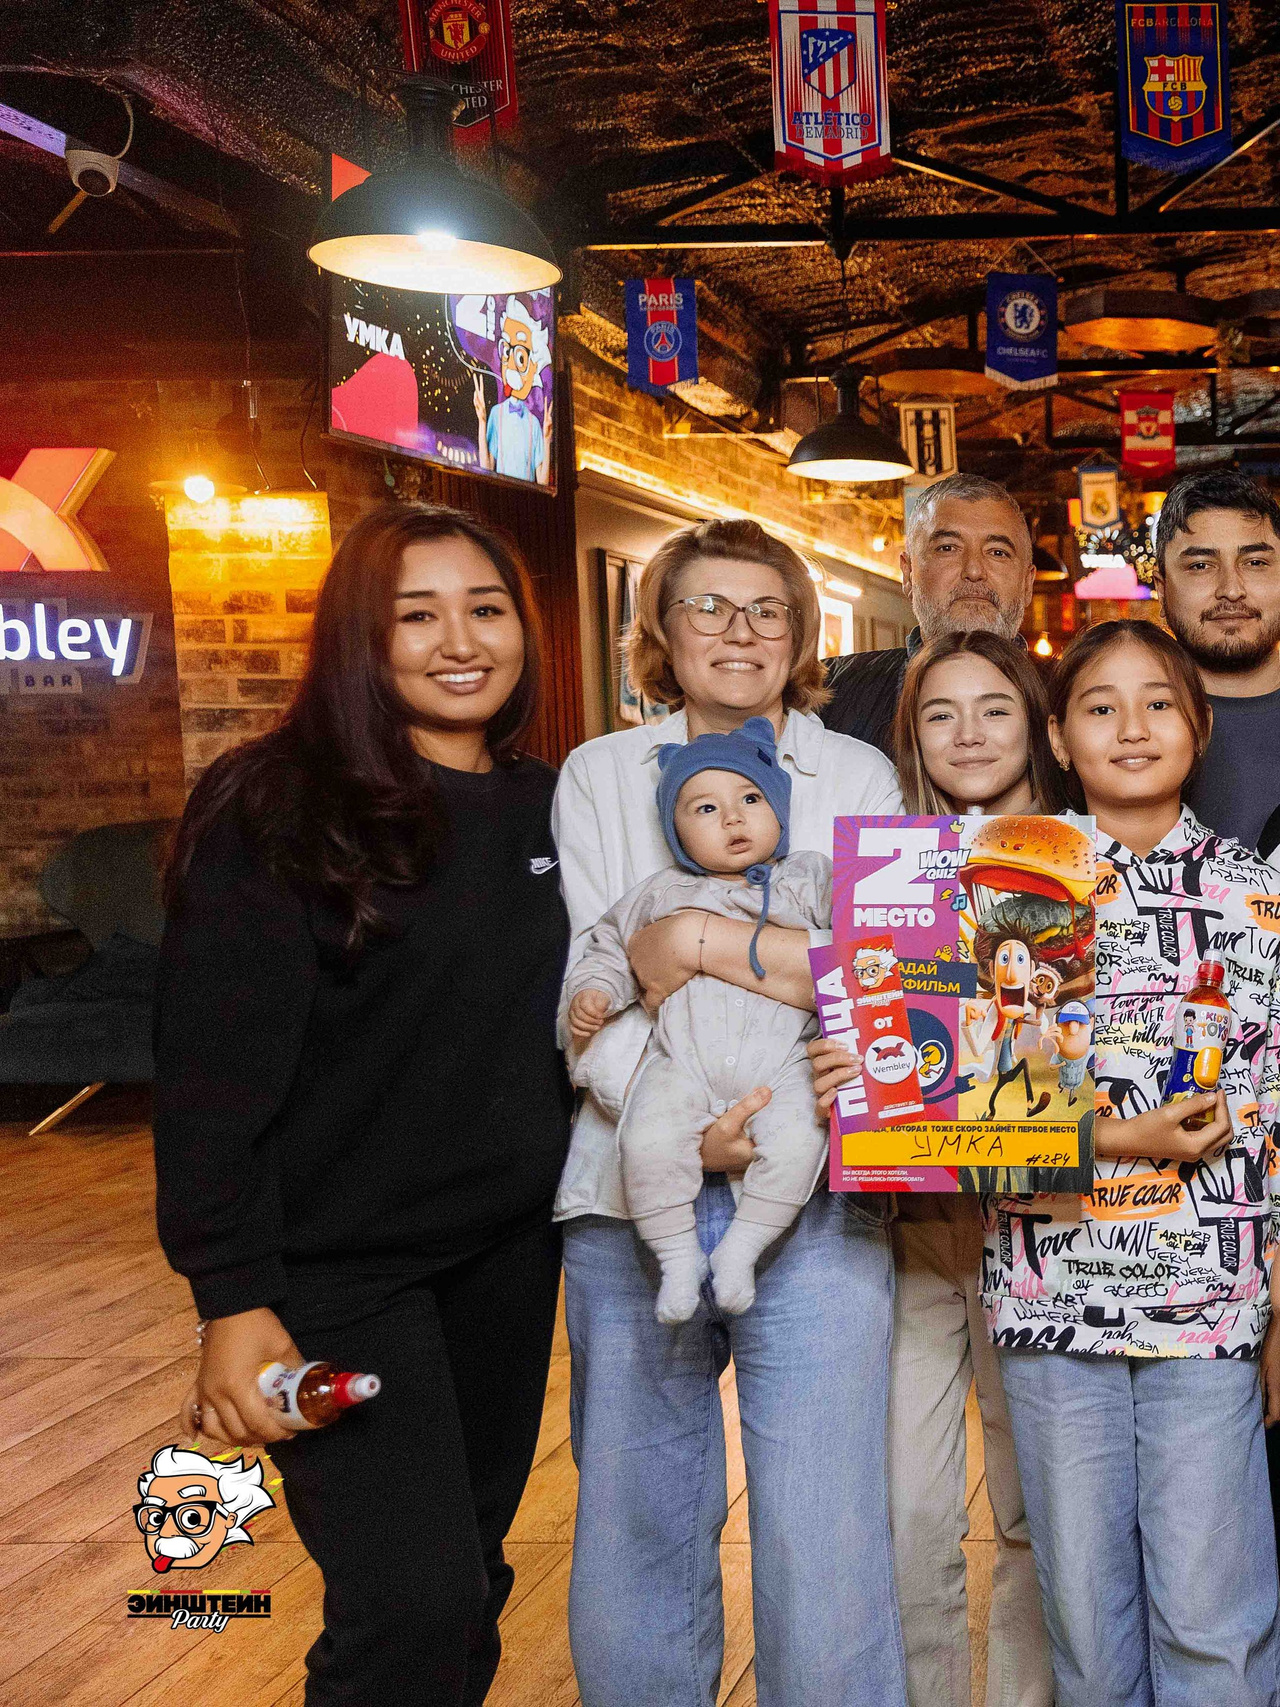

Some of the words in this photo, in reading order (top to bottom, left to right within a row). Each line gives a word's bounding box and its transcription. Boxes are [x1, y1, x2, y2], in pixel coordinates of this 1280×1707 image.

[441, 45, 478, 59] UNITED
[792, 110, 871, 126] ATLÉTICO
[638, 292, 684, 306] PARIS
[343, 313, 406, 361] УМКА
[24, 674, 73, 688] BAR
[853, 827, 940, 905] 2
[918, 848, 971, 870] WOW
[925, 867, 958, 881] QUIZ
[853, 907, 936, 928] МЕСТО
[898, 960, 938, 976] АДАЙ
[901, 977, 961, 994] ФИЛЬМ
[1205, 1011, 1229, 1025] KID'S
[1197, 1022, 1229, 1042] TOYS
[816, 965, 870, 1118] ПЦЦА
[872, 1060, 911, 1075] Wembley
[891, 1125, 928, 1133] КОТОРАЯ
[931, 1125, 954, 1133] ТОЖЕ
[955, 1125, 983, 1133] СКОРО
[1017, 1125, 1049, 1133] ПЕРВОЕ
[1050, 1126, 1077, 1134] МЕСТО
[910, 1133, 1004, 1159] УМКА
[1088, 1183, 1135, 1208] TRUE
[1131, 1181, 1183, 1207] COLOR
[1062, 1258, 1116, 1280] TRUE
[1119, 1261, 1182, 1283] COLOR
